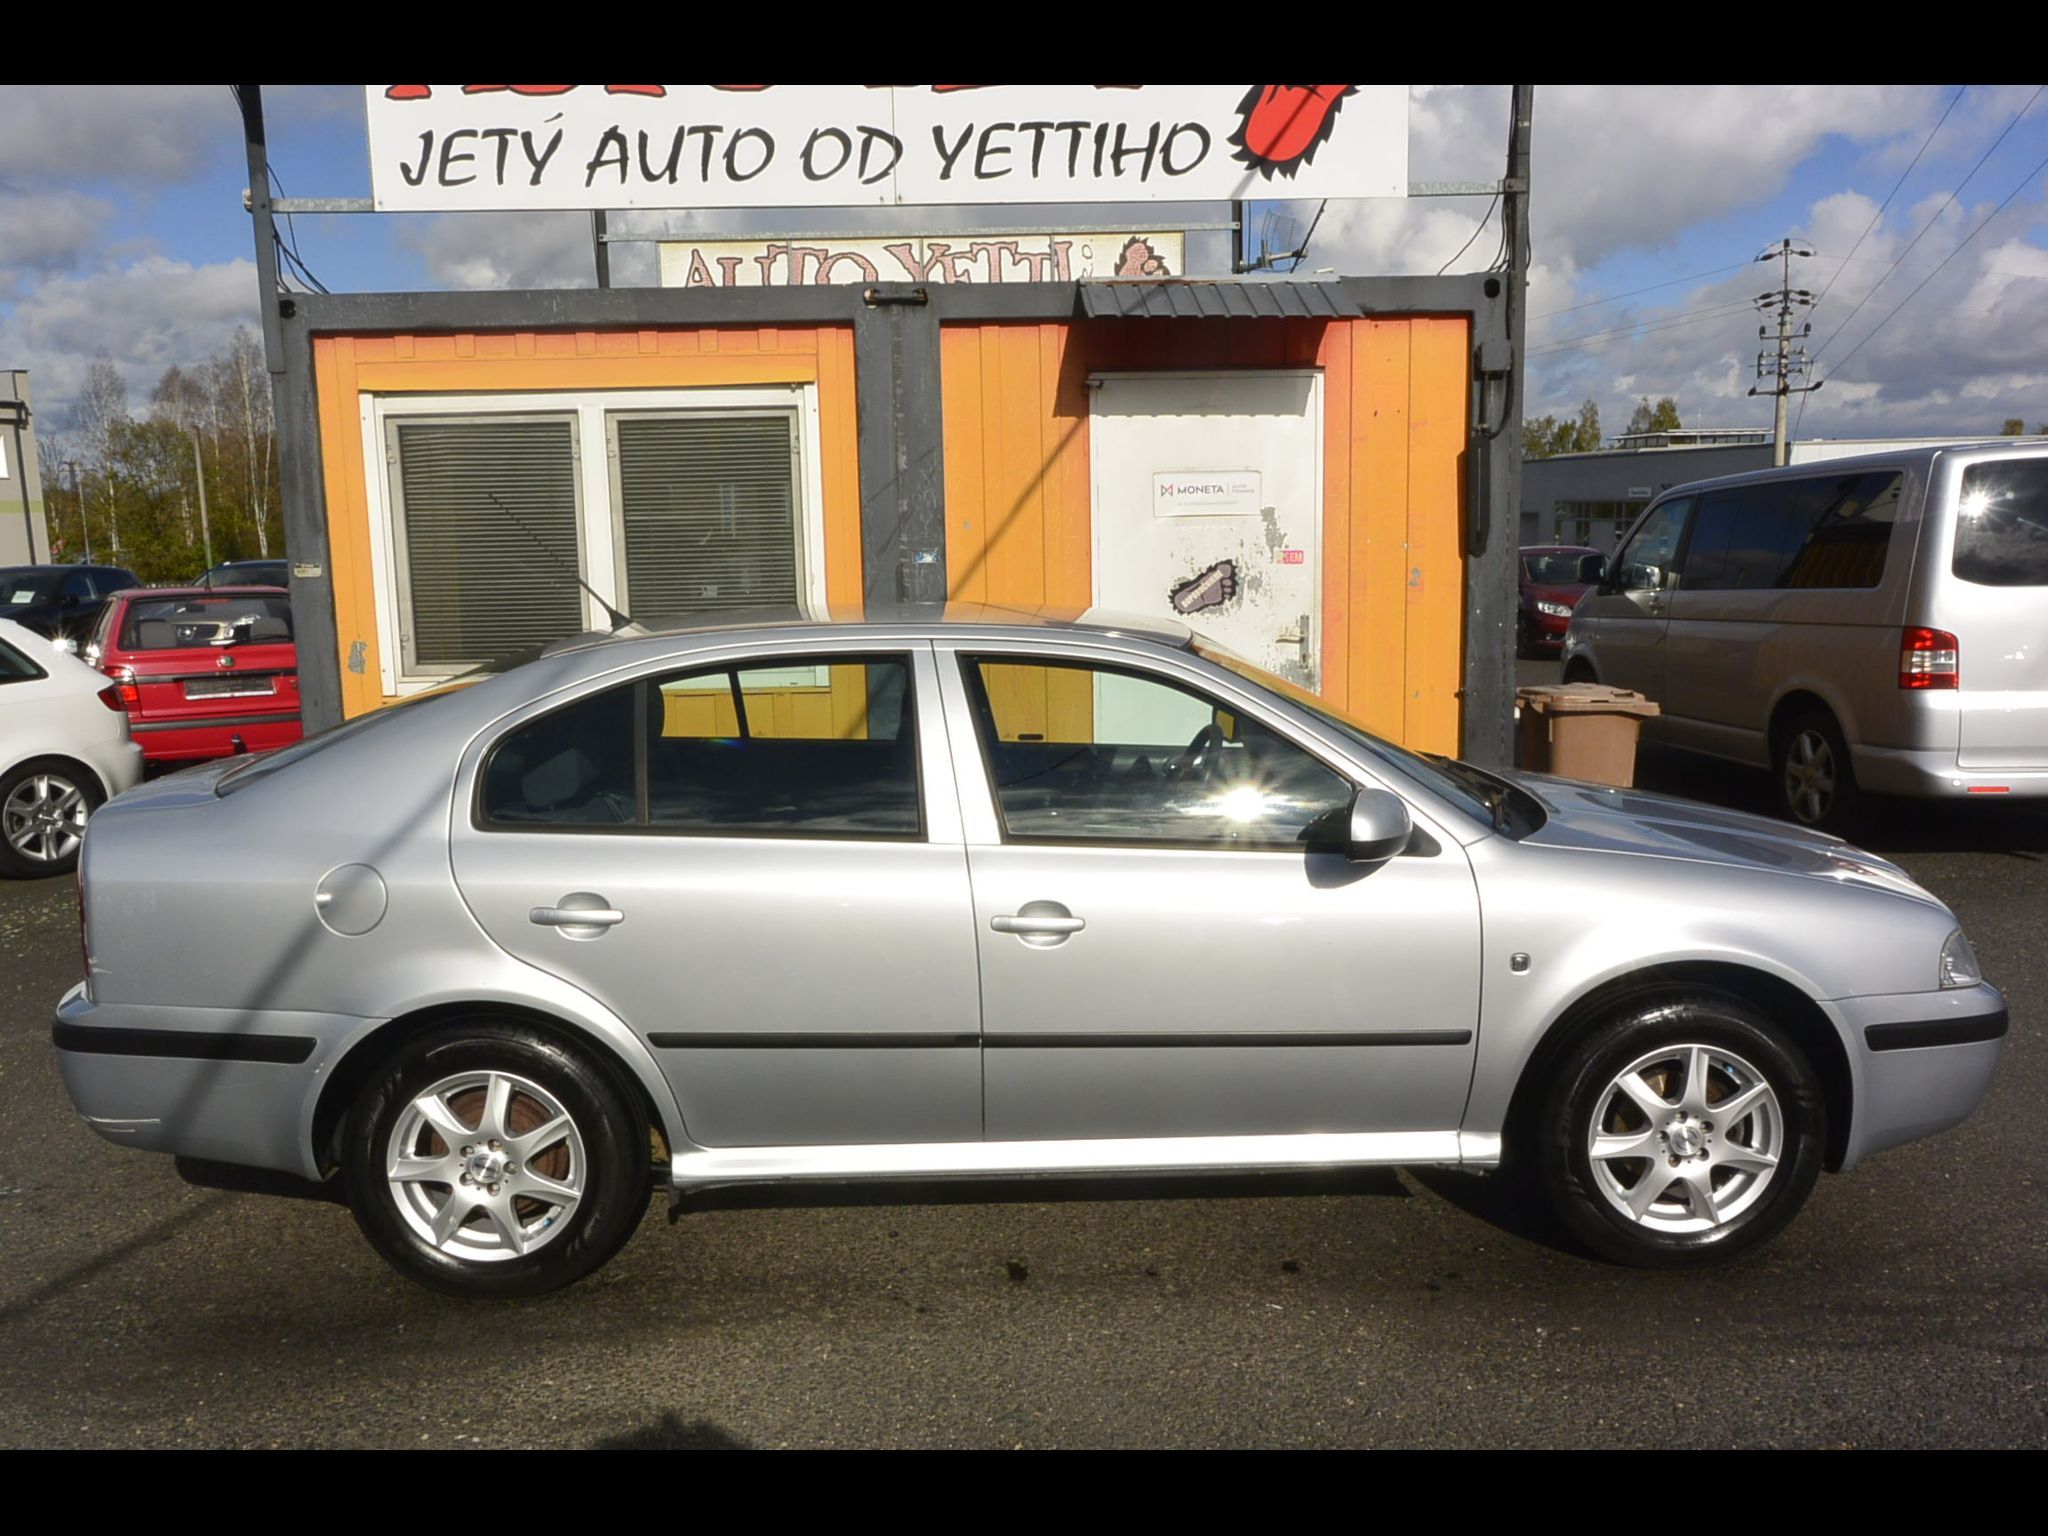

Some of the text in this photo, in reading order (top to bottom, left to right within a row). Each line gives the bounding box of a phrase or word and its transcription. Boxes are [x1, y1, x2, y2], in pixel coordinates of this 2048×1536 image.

[399, 112, 1212, 188] JETÝ AUTO OD YETTIHO
[1177, 484, 1225, 495] MONETA
